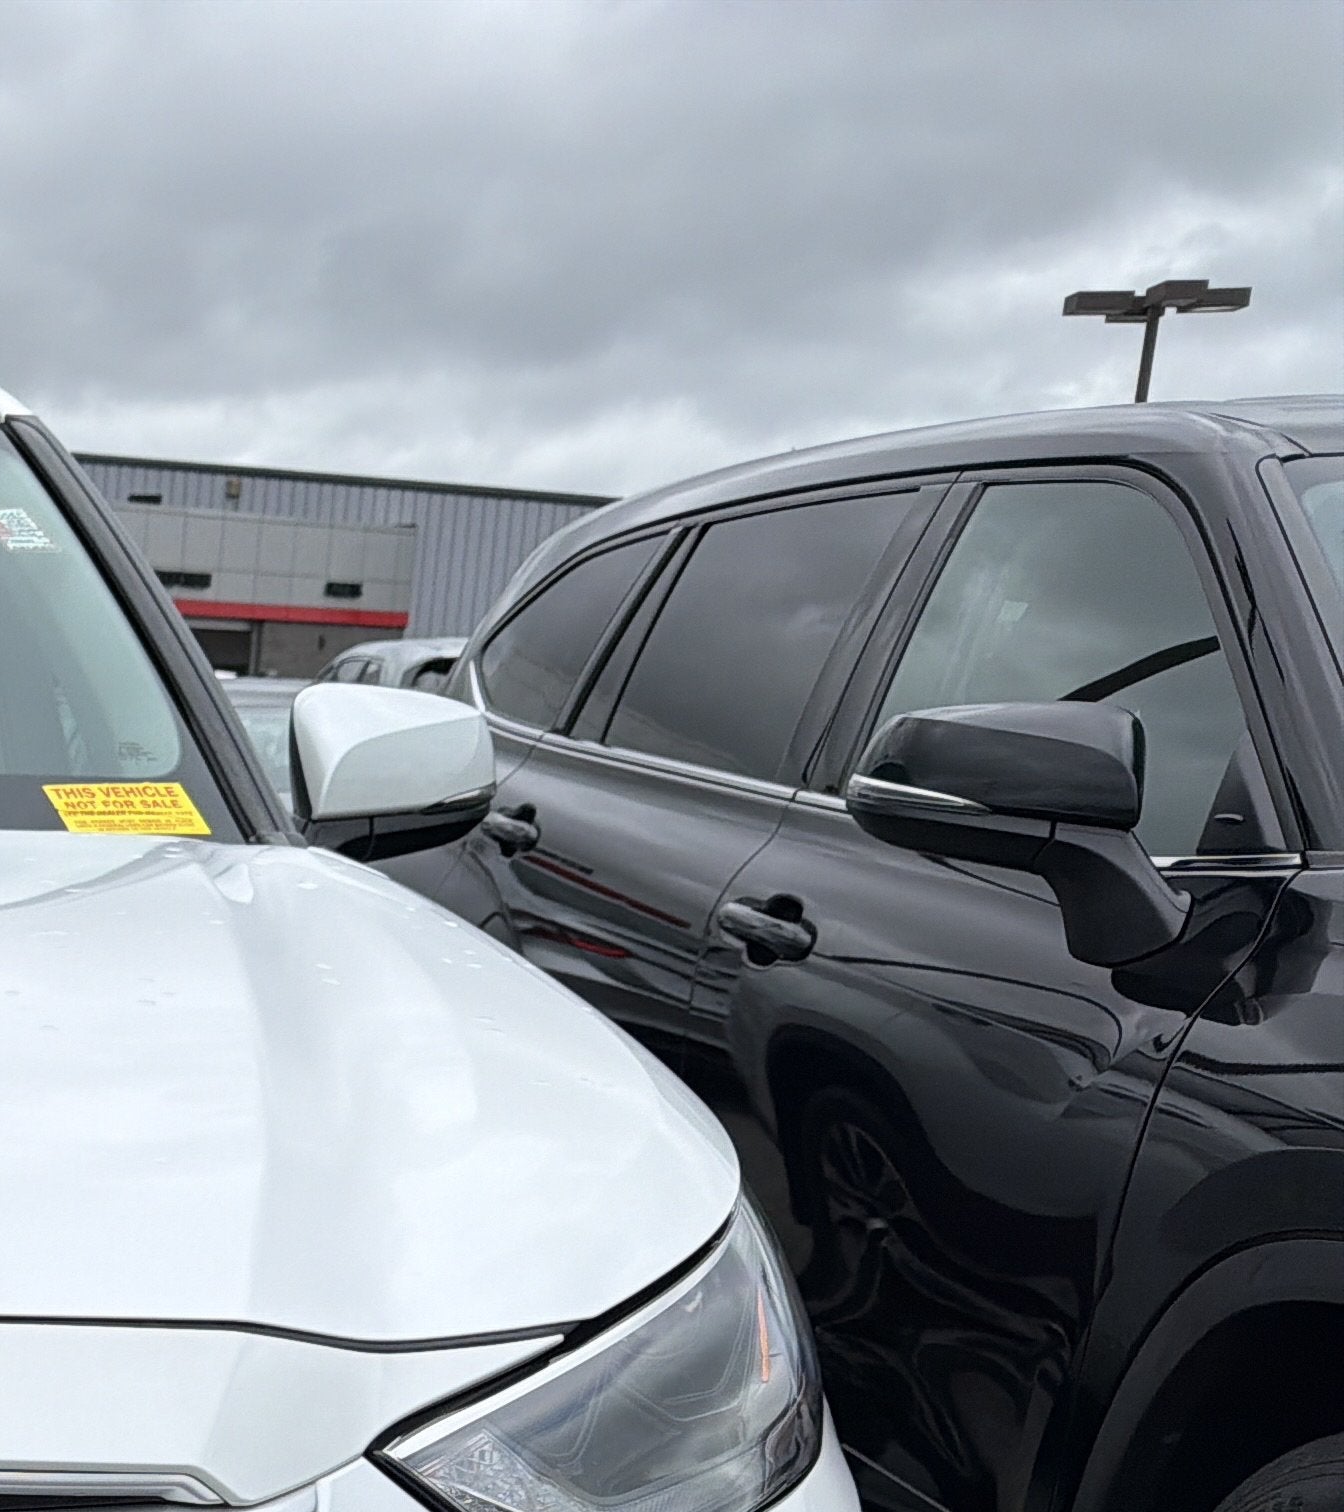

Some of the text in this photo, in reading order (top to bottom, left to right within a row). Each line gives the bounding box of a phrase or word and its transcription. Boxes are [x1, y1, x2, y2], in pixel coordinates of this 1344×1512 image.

[52, 785, 179, 799] THIS VEHICLE
[64, 799, 182, 810] NOT FOR SALE
